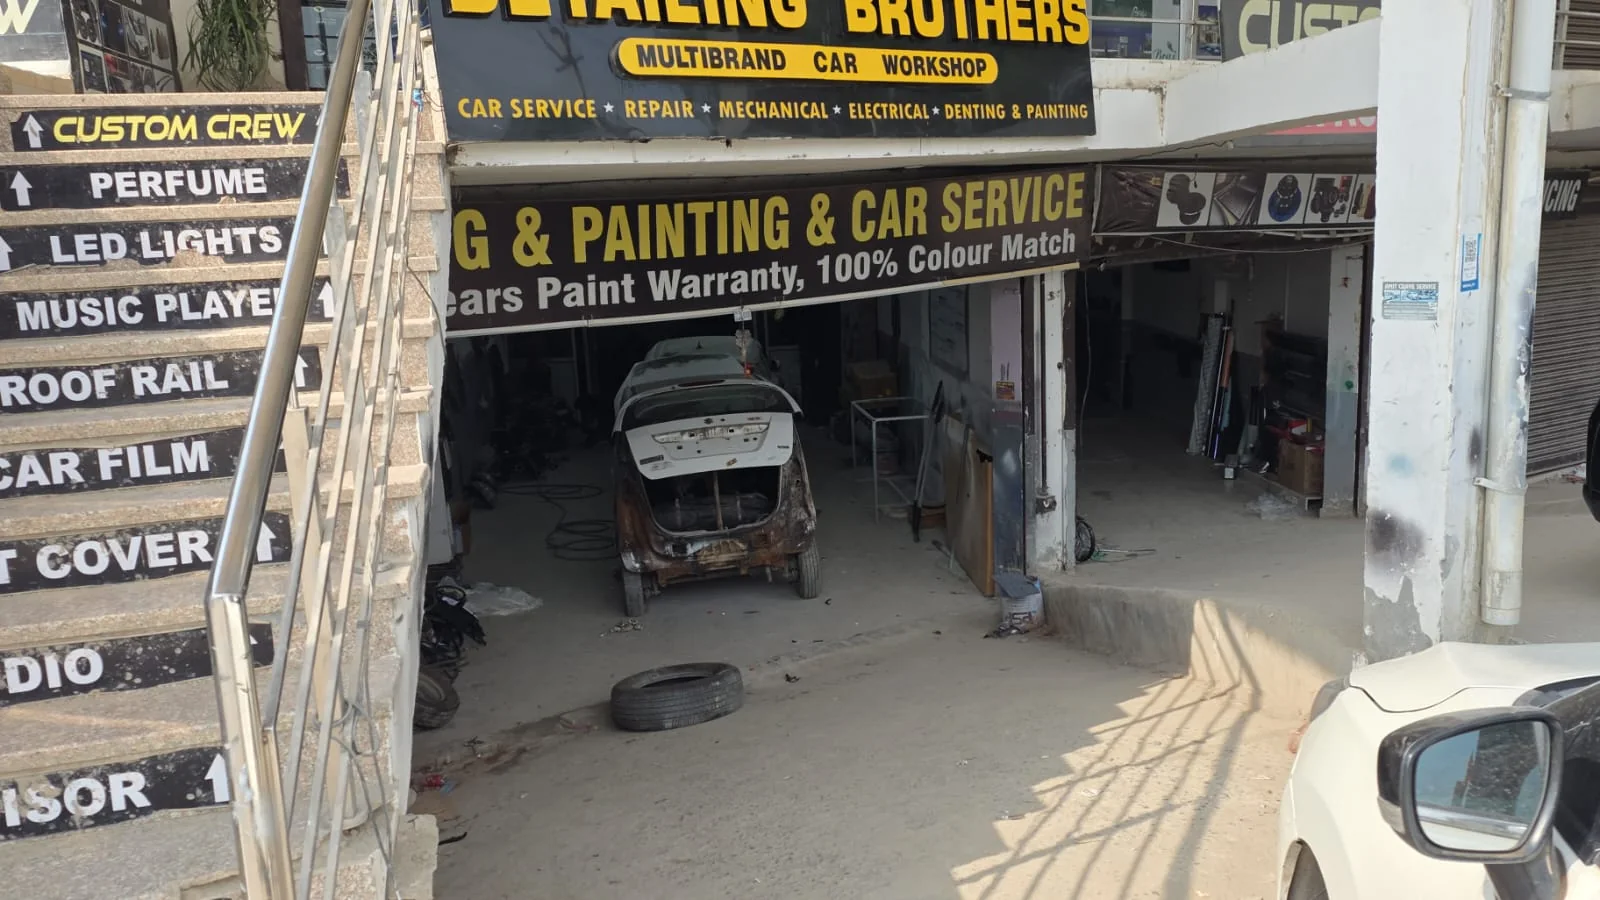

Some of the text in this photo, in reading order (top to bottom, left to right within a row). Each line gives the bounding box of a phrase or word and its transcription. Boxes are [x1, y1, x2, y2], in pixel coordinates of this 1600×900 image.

[449, 0, 1089, 44] ILING BROTHERS
[1239, 0, 1381, 55] CUST
[636, 44, 987, 78] MULTIBRAND CAR WORKSHOP
[53, 112, 305, 143] CUSTOM CREW
[457, 98, 1088, 120] CAR SERVICE REPAIR MECHANICAL ELECTRICAL DENTING & PAINTING
[90, 167, 267, 199] PERFUME
[453, 172, 1086, 271] G & PAINTING & CAR SERVICE
[50, 226, 282, 263] LED LIGHTS
[537, 273, 636, 310] Paint
[647, 260, 804, 303] Warranty,
[816, 247, 898, 285] 100%
[908, 242, 993, 274] Colour
[1001, 227, 1077, 262] Match
[16, 287, 281, 332] MUSIC PLAYE
[0, 361, 229, 407] ROOF RAIL
[99, 440, 210, 481] FILM
[36, 530, 214, 580] COVER
[4, 647, 104, 694] DIO
[2, 771, 152, 827] ISOR
